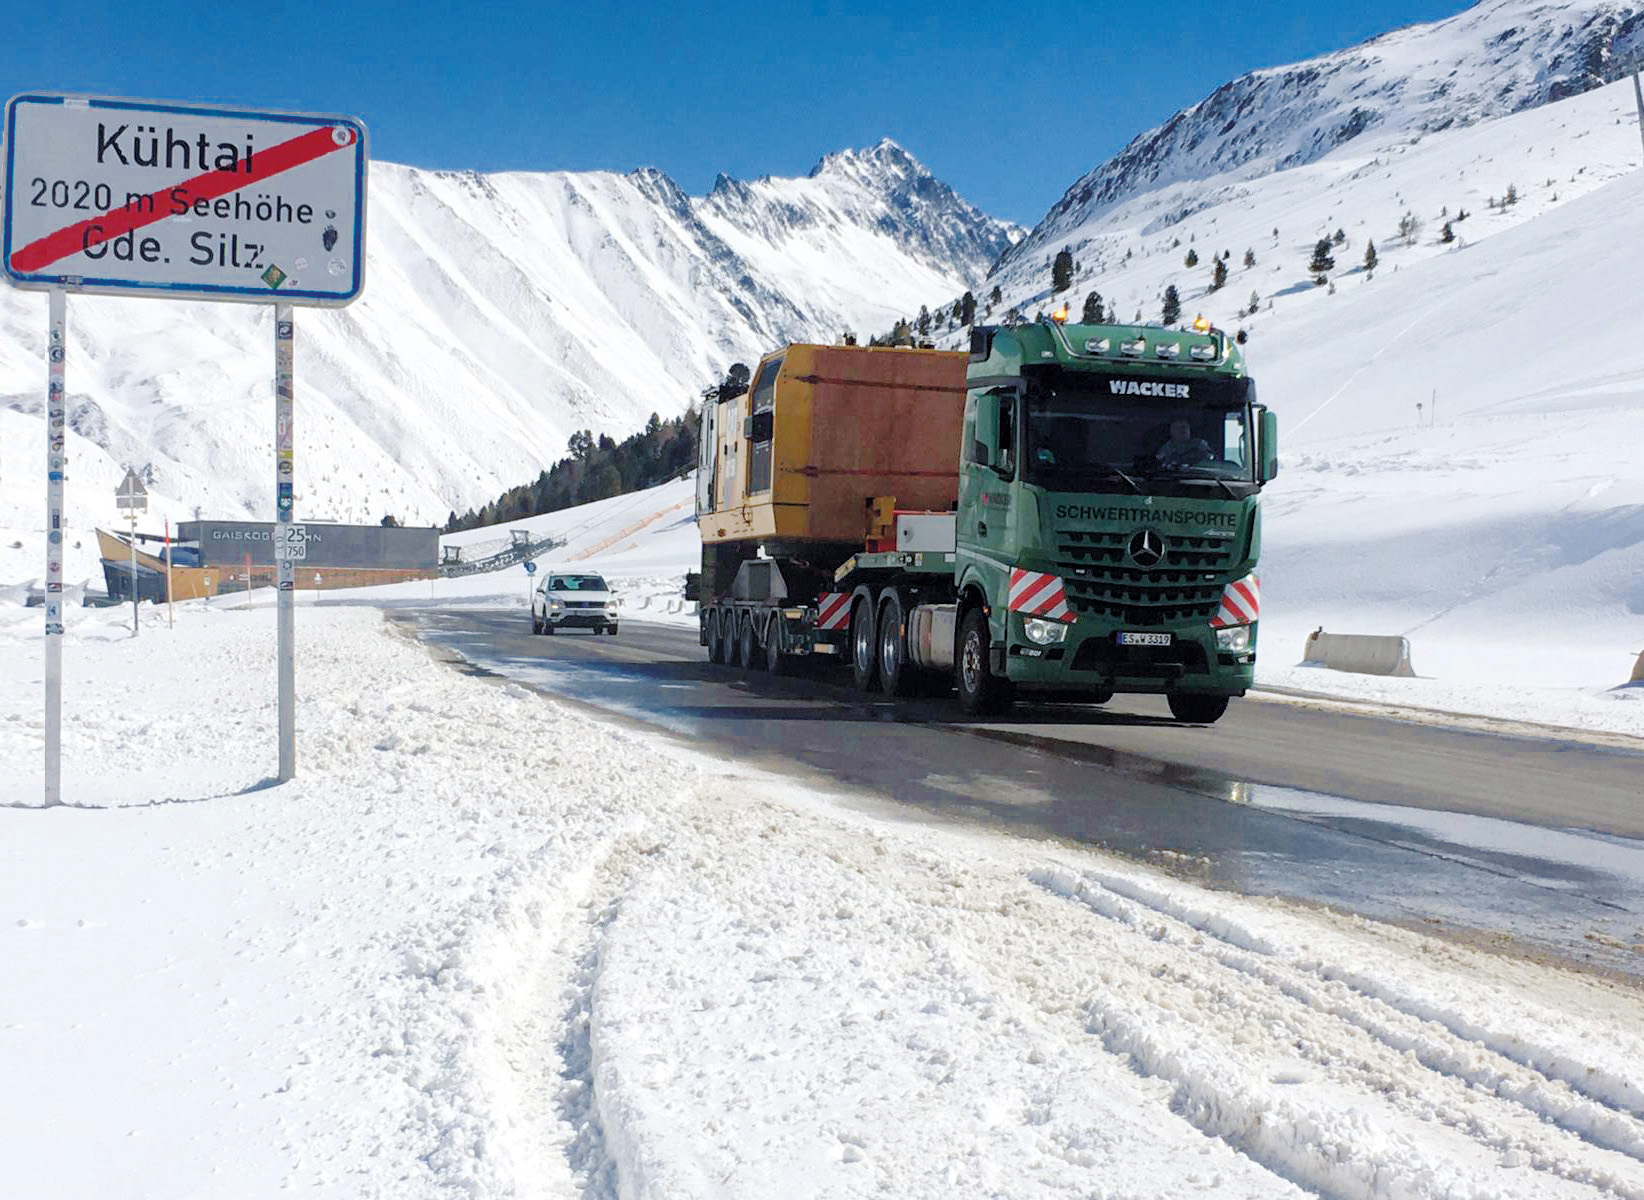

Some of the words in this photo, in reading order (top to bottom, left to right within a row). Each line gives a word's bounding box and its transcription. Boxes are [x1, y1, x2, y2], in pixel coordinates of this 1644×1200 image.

[97, 122, 254, 174] Kühtai
[31, 177, 112, 211] 2020
[125, 192, 154, 213] m
[170, 188, 314, 224] Seehöhe
[82, 224, 171, 264] Gde.
[189, 231, 265, 269] Silz
[1109, 380, 1190, 399] WACKER
[1056, 504, 1237, 527] SCHWERTRANSPORTE
[287, 528, 305, 543] 25
[287, 546, 304, 557] 750
